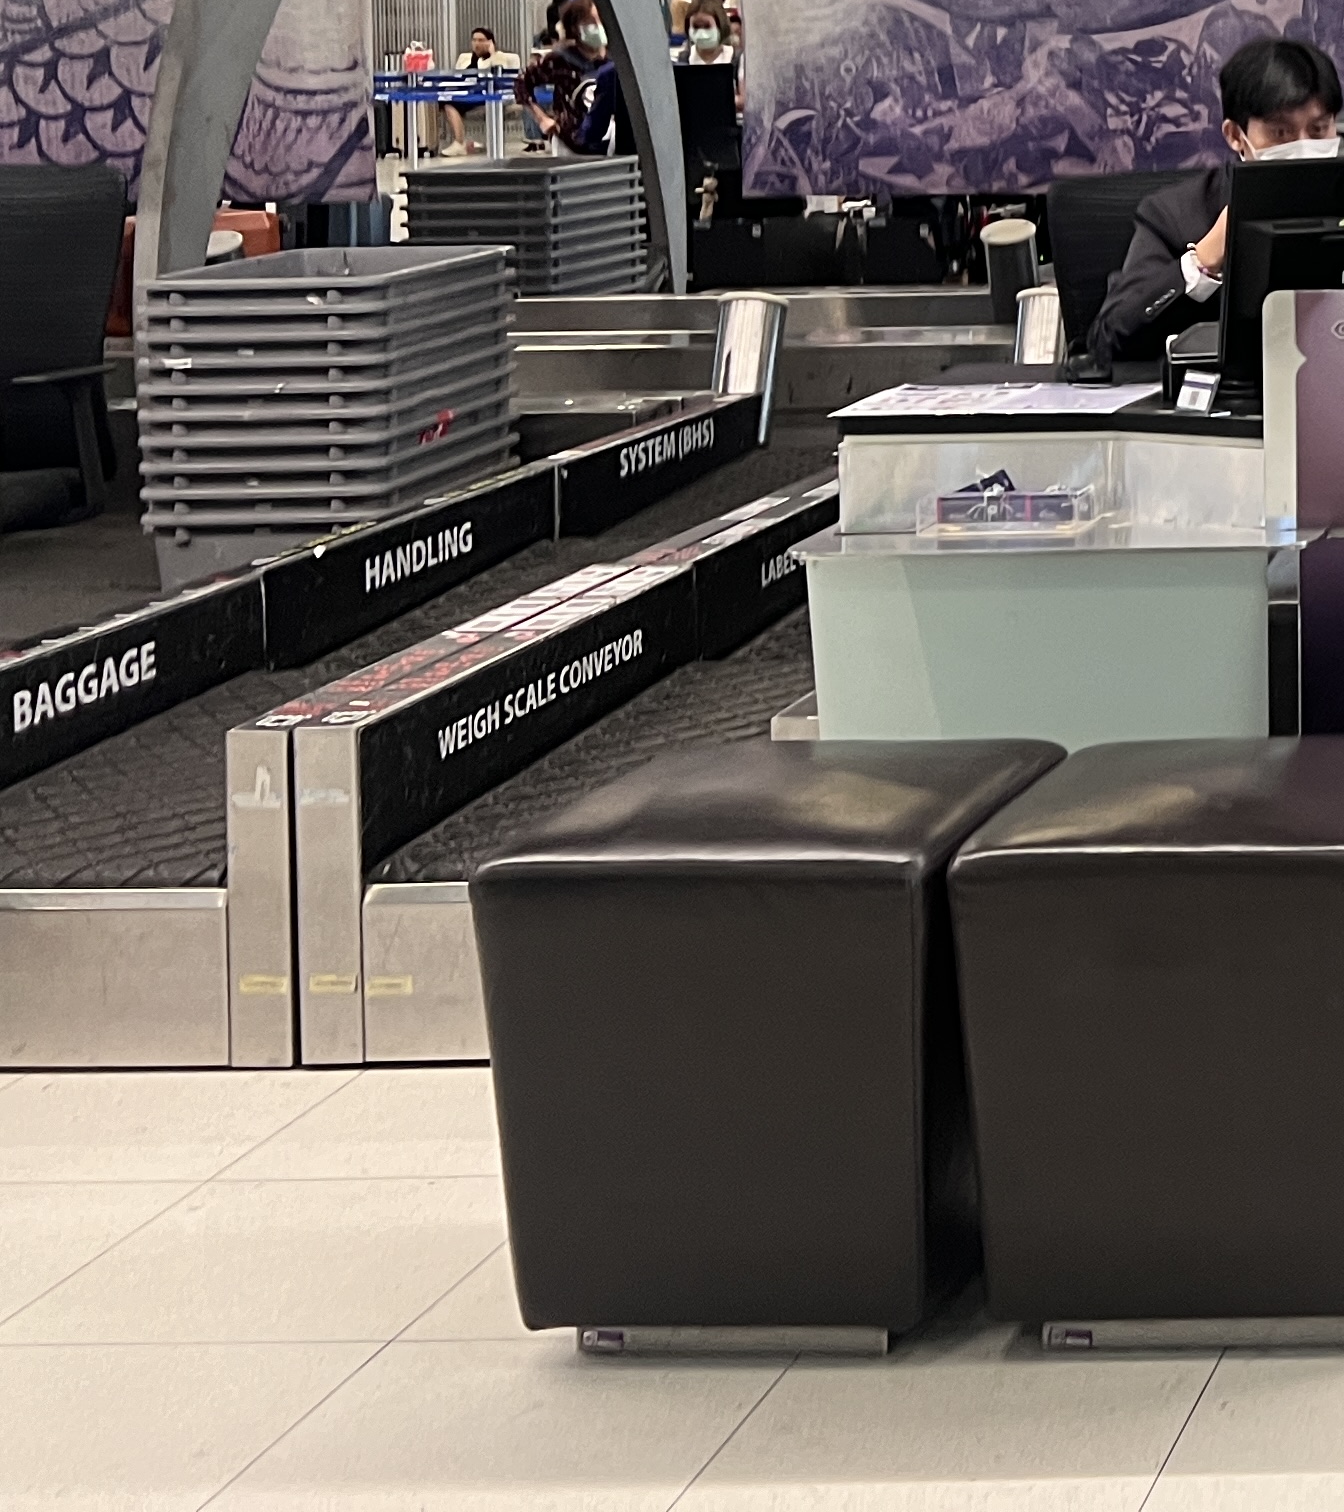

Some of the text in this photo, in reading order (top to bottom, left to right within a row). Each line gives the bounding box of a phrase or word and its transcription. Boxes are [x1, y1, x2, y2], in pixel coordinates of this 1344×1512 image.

[620, 416, 715, 477] SYSTEM (BHS)
[365, 521, 473, 593] HANDLING
[761, 550, 797, 588] LABEL
[13, 640, 158, 734] BAGGAGE
[437, 700, 500, 761] WEIGH
[504, 671, 556, 726] SCALE
[559, 628, 643, 694] CONVEYOR
